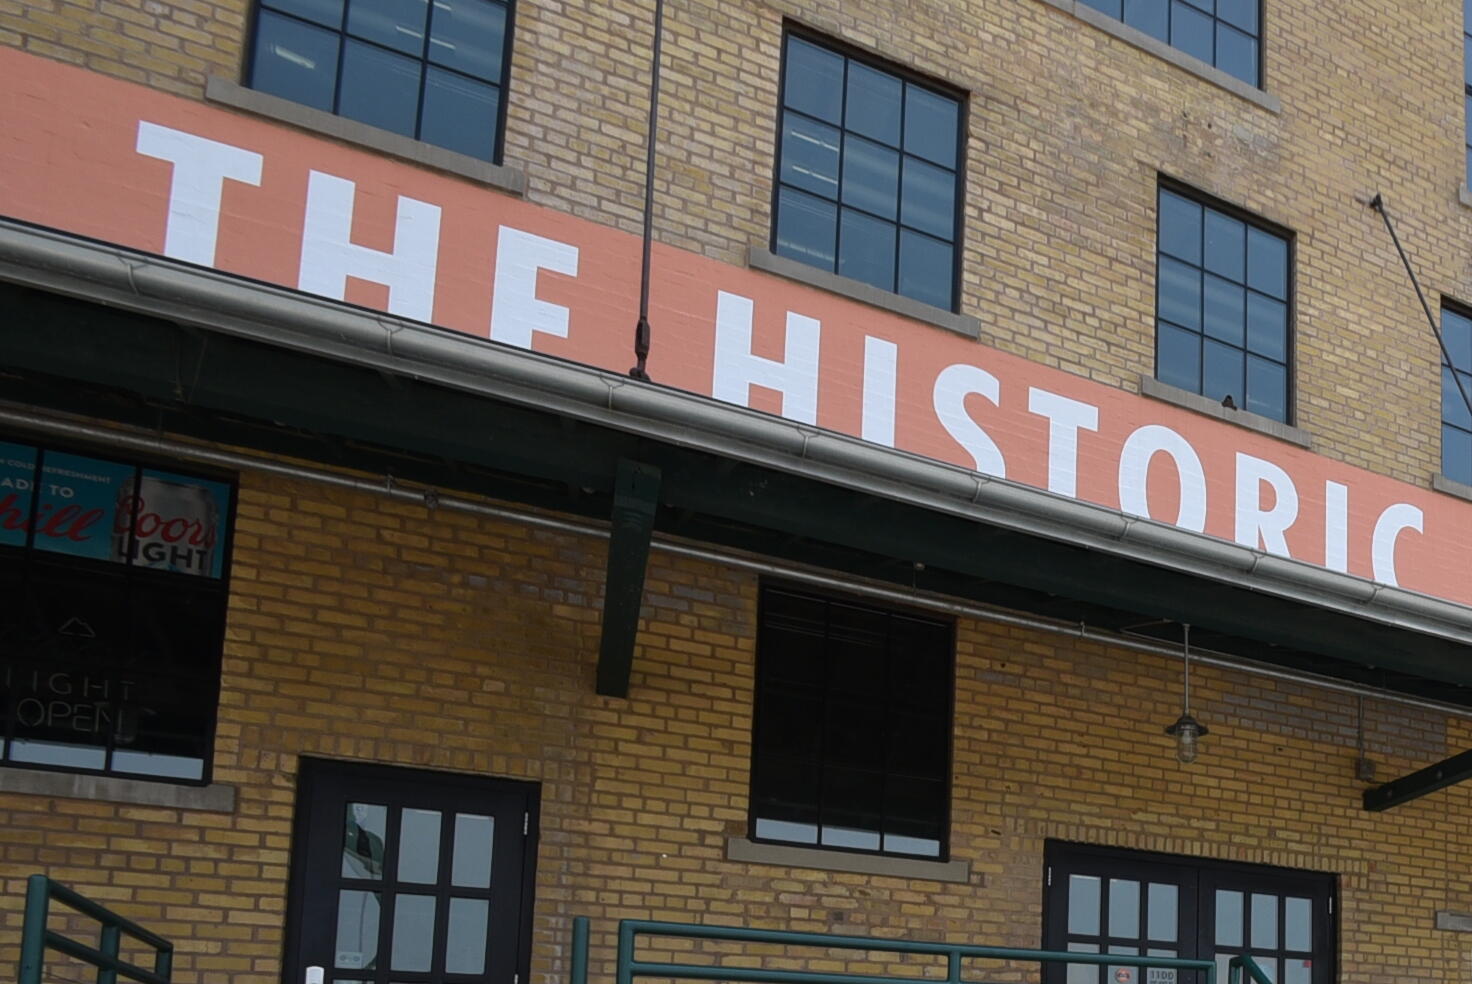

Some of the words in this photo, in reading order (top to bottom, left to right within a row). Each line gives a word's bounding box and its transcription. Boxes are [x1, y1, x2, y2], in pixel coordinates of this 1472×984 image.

[712, 290, 1423, 587] HISTORIC
[42, 465, 112, 484] EFRESHMENT
[49, 484, 75, 498] TO
